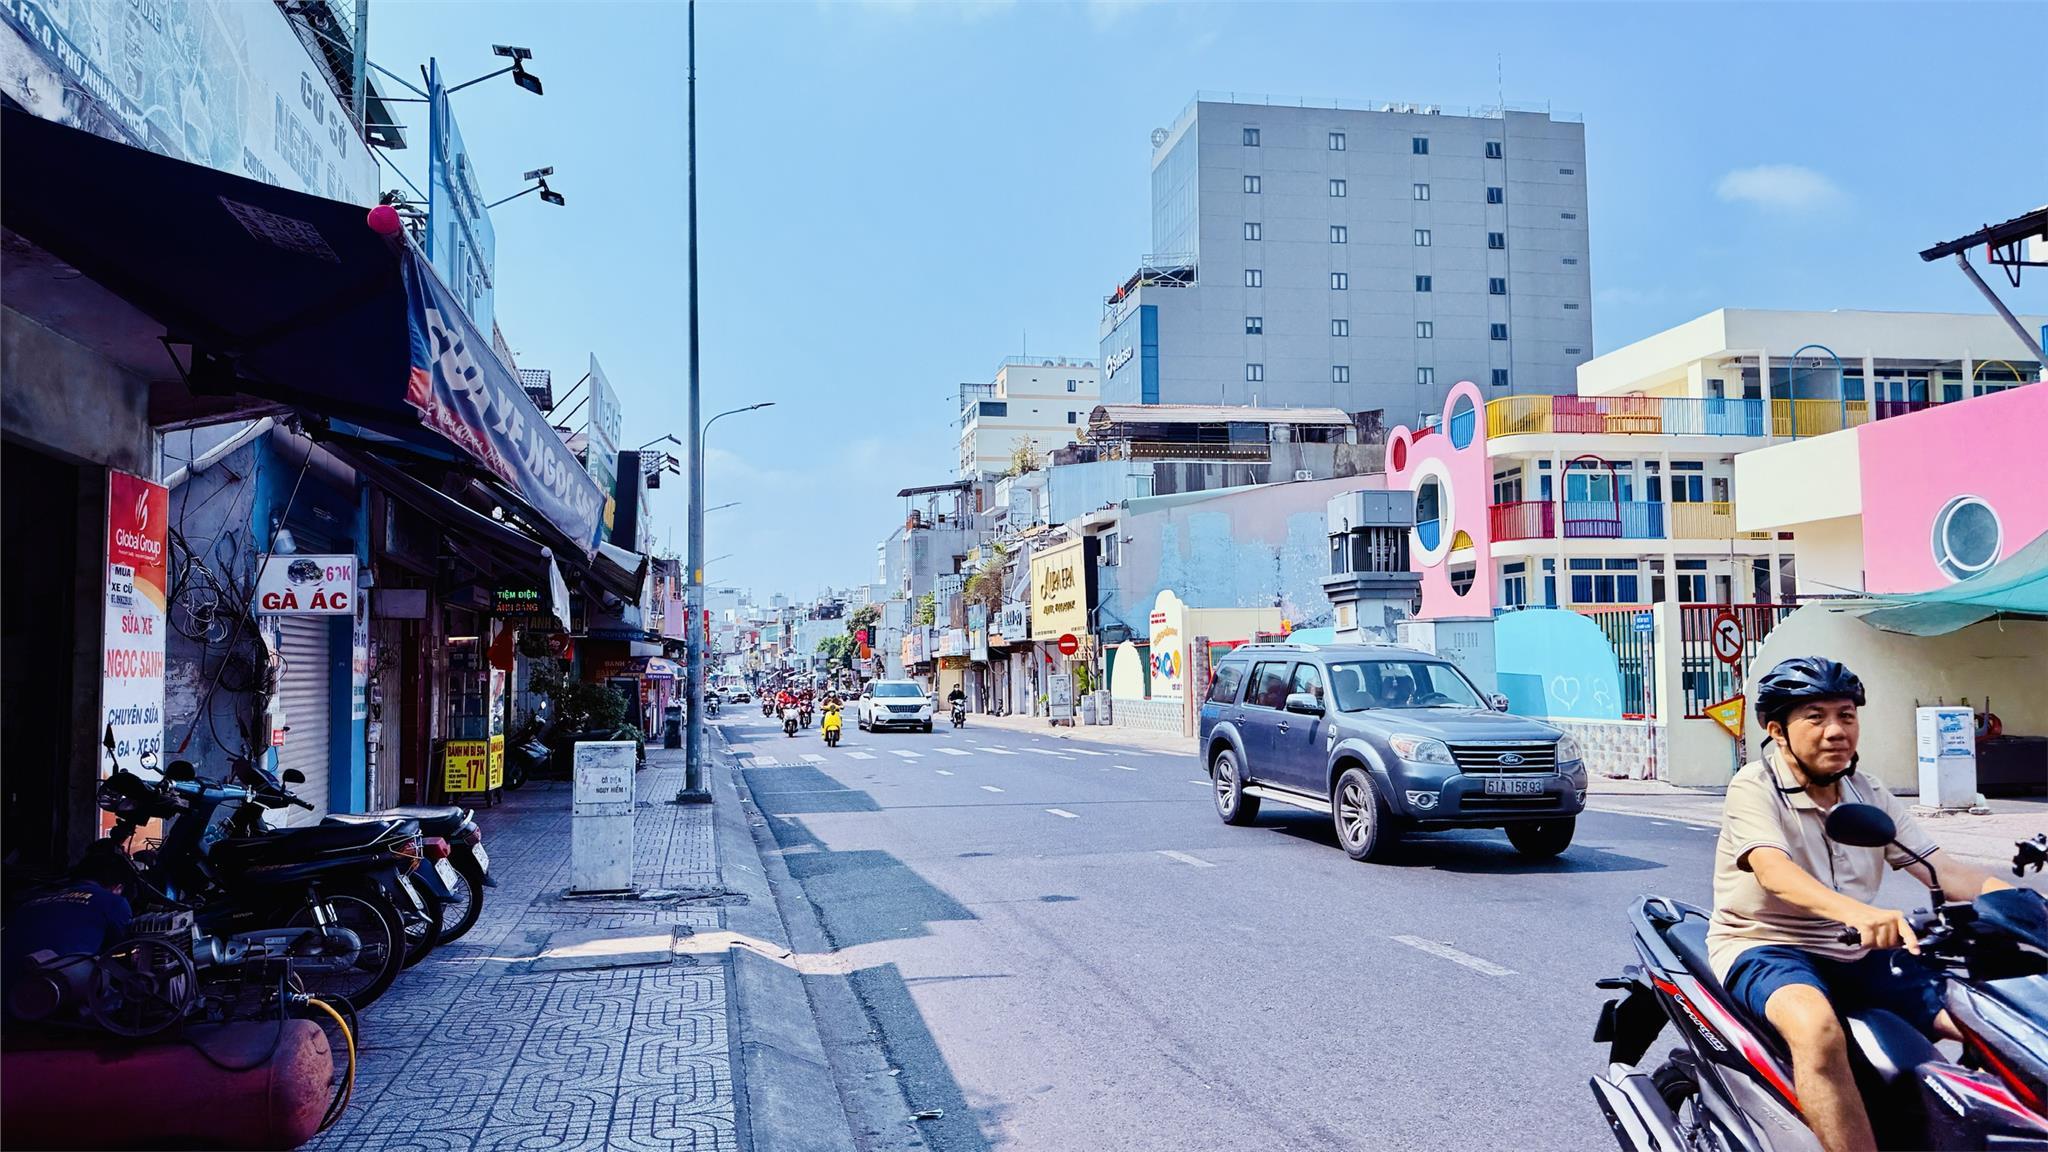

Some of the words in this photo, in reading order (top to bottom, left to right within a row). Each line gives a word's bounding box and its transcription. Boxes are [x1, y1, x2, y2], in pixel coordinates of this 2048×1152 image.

[115, 528, 139, 550] Global
[139, 533, 161, 559] Group
[114, 566, 132, 578] MUA
[111, 582, 121, 592] XE
[122, 582, 133, 594] CŨ
[262, 587, 299, 610] GÀ
[309, 587, 348, 610] ÁC
[496, 588, 516, 601] TIỆM
[518, 588, 538, 601] ĐIỆN
[121, 609, 140, 634] SỬA
[142, 615, 153, 635] XE
[106, 648, 138, 687] NGỌC
[139, 649, 163, 679] SANH
[107, 703, 143, 727] CHUYÊN
[143, 702, 159, 725] SỬA
[117, 740, 130, 758] GA
[149, 730, 162, 755] SỐ
